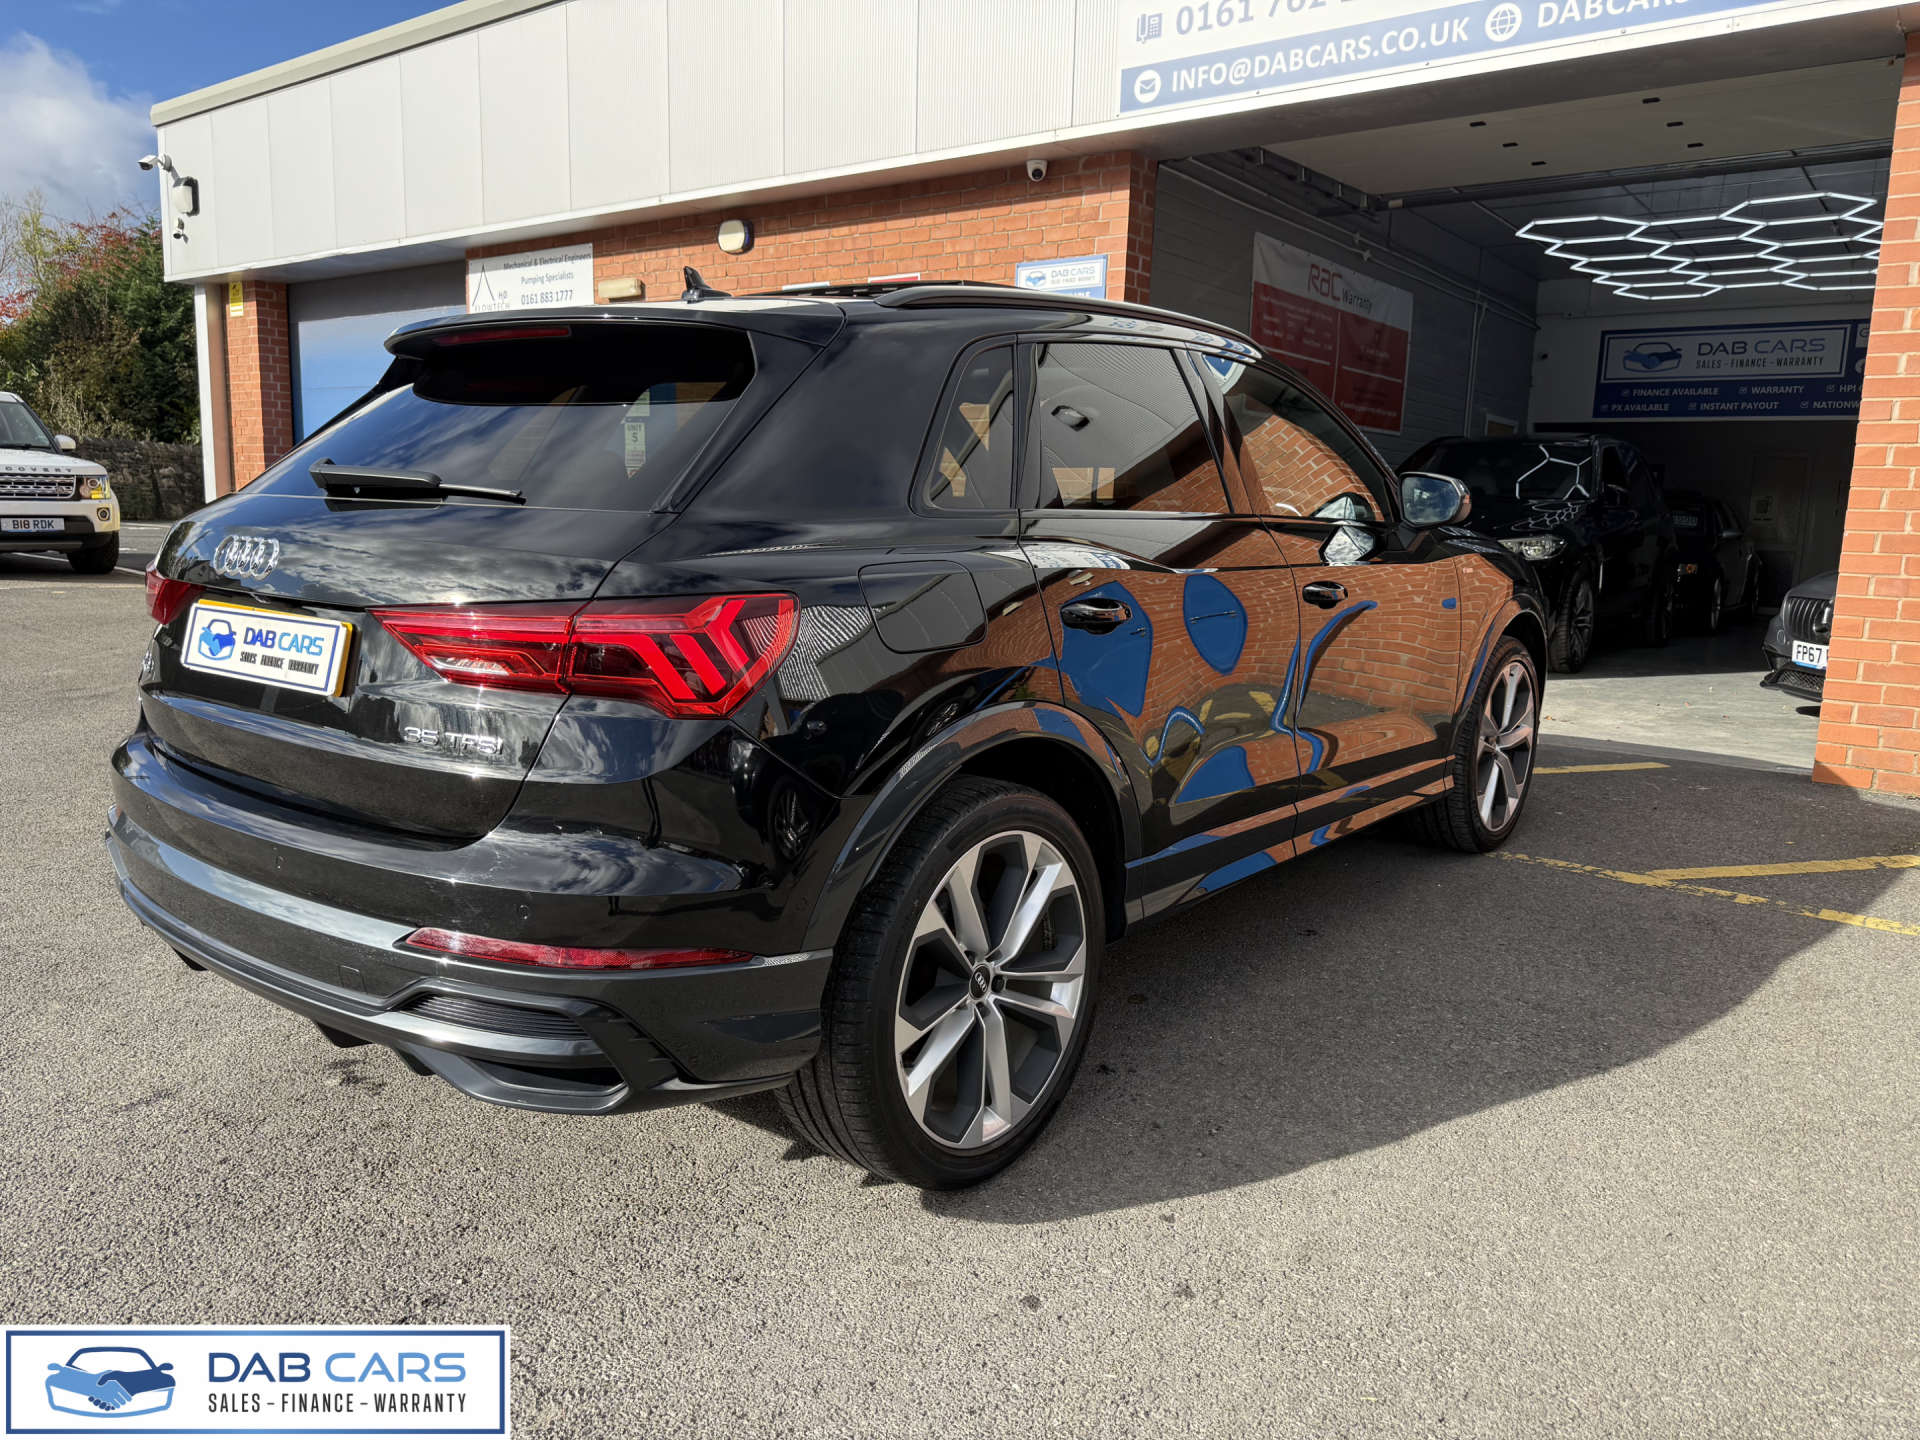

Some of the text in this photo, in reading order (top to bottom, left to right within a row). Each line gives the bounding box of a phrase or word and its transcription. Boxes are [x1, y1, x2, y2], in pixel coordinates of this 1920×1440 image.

[1176, 0, 1255, 36] 0161
[1171, 16, 1471, 93] INFO@DABCARS.CO.UK
[521, 293, 538, 306] 0161
[556, 289, 573, 303] 1777
[1342, 286, 1373, 315] Warranty
[1697, 338, 1826, 356] DAB CARS
[1696, 358, 1722, 369] SALES
[1730, 357, 1768, 369] FINANCE
[1776, 357, 1825, 367] WARRANTY
[1632, 387, 1720, 397] FINANCE AVAILABLE
[1751, 386, 1805, 394] WARRANTY
[1700, 401, 1780, 410] INSTANT PAYOUT
[33, 519, 55, 529] RDK
[243, 627, 325, 657] DAB CARS
[1796, 644, 1822, 664] FP67
[404, 726, 504, 755] 35 TFSI
